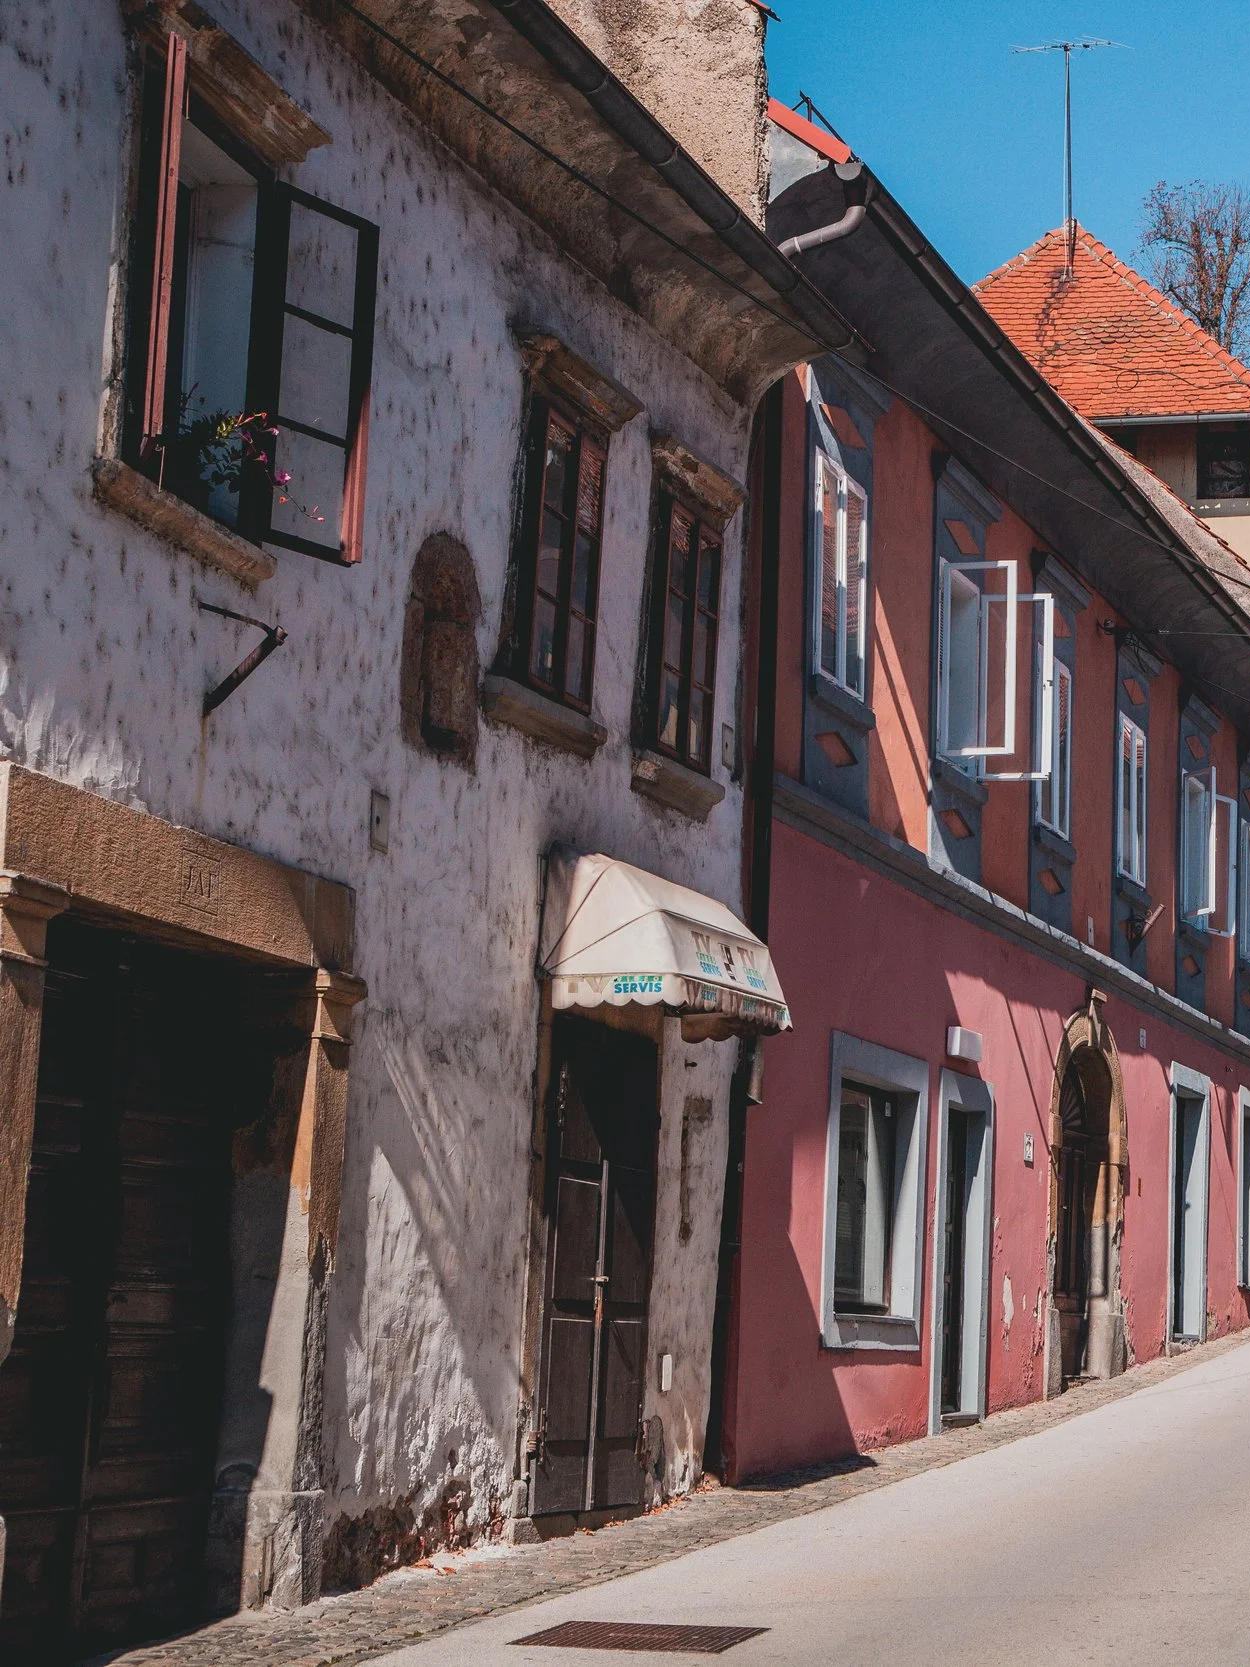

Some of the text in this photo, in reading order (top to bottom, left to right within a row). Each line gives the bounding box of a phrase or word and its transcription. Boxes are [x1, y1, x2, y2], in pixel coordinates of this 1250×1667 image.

[691, 931, 711, 955] TV
[737, 946, 756, 968] TV
[562, 976, 610, 993] TV
[614, 982, 662, 994] SERVIS
